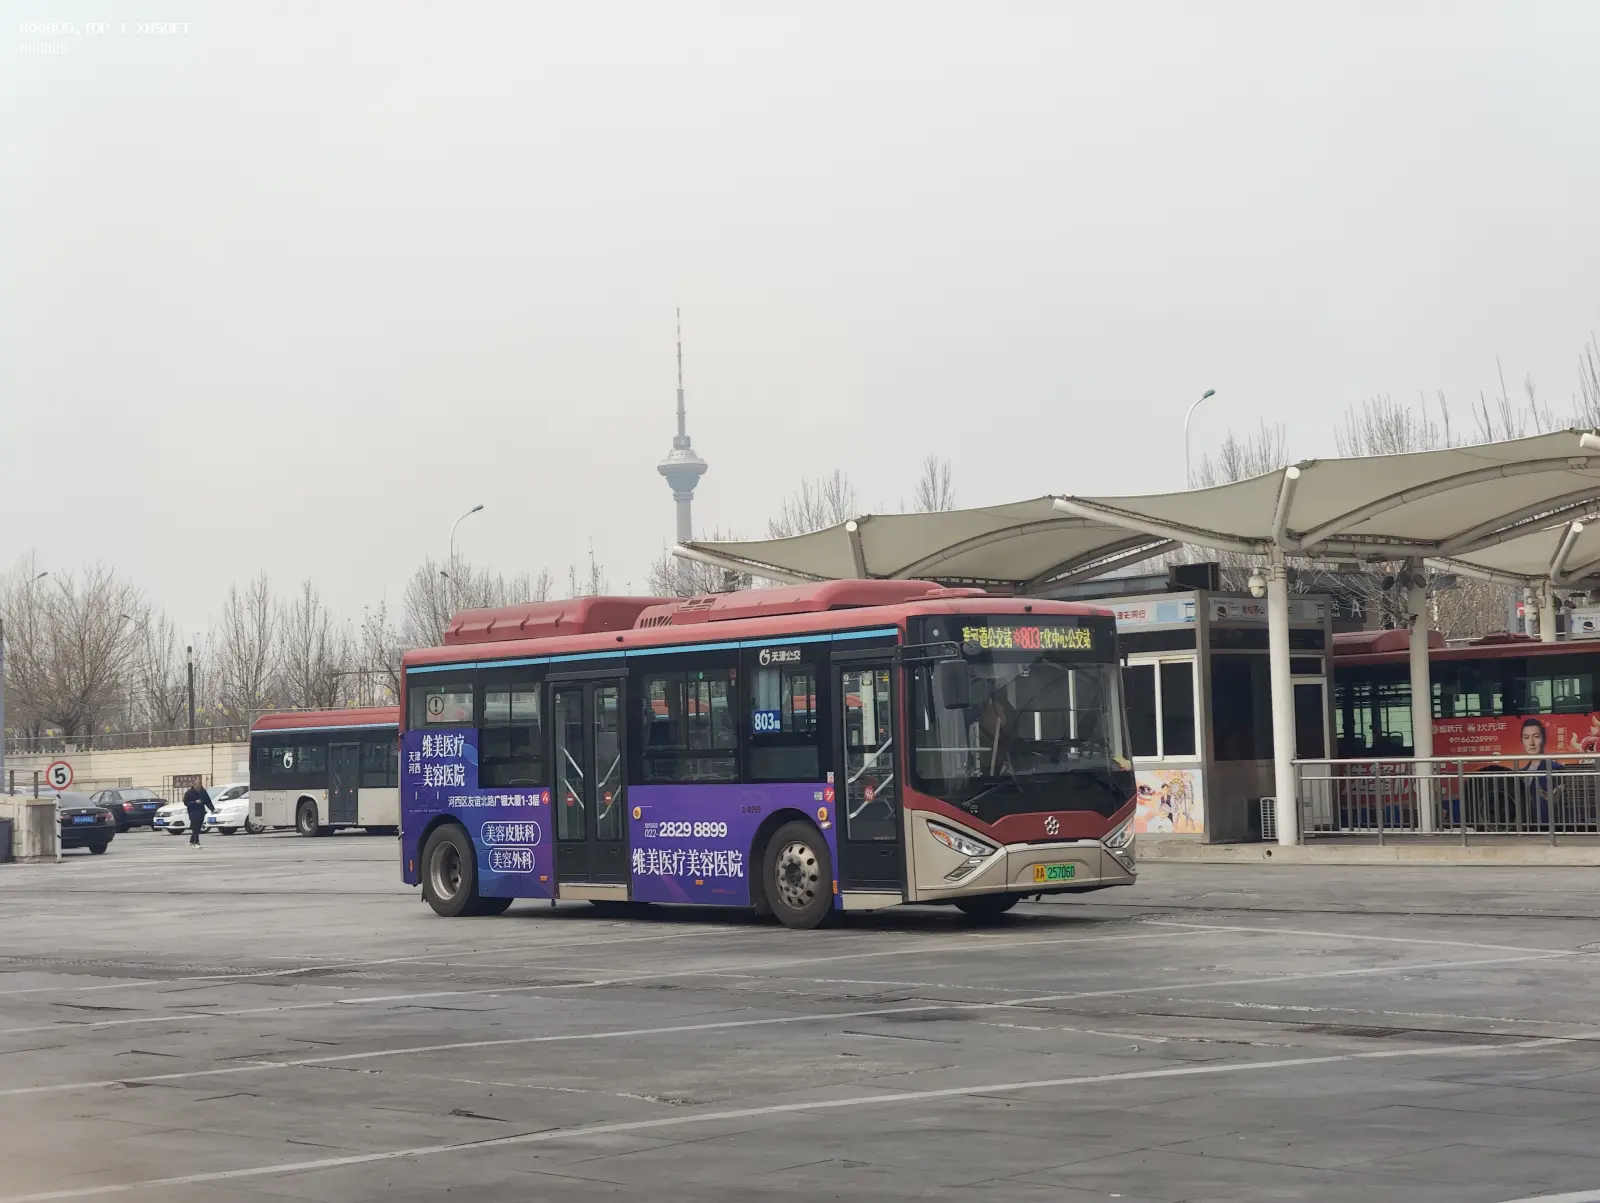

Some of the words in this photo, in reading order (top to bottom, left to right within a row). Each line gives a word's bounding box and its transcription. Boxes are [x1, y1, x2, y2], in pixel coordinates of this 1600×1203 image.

[422, 733, 465, 758] 维美医疗
[408, 751, 421, 762] 天津
[54, 767, 67, 785] 5
[408, 763, 421, 774] 河西
[422, 762, 465, 787] 美容医院
[486, 824, 535, 842] 美容皮肤科
[693, 821, 728, 838] 8899
[492, 851, 532, 869] 美容外科
[632, 848, 744, 878] 维美医疗美容医院
